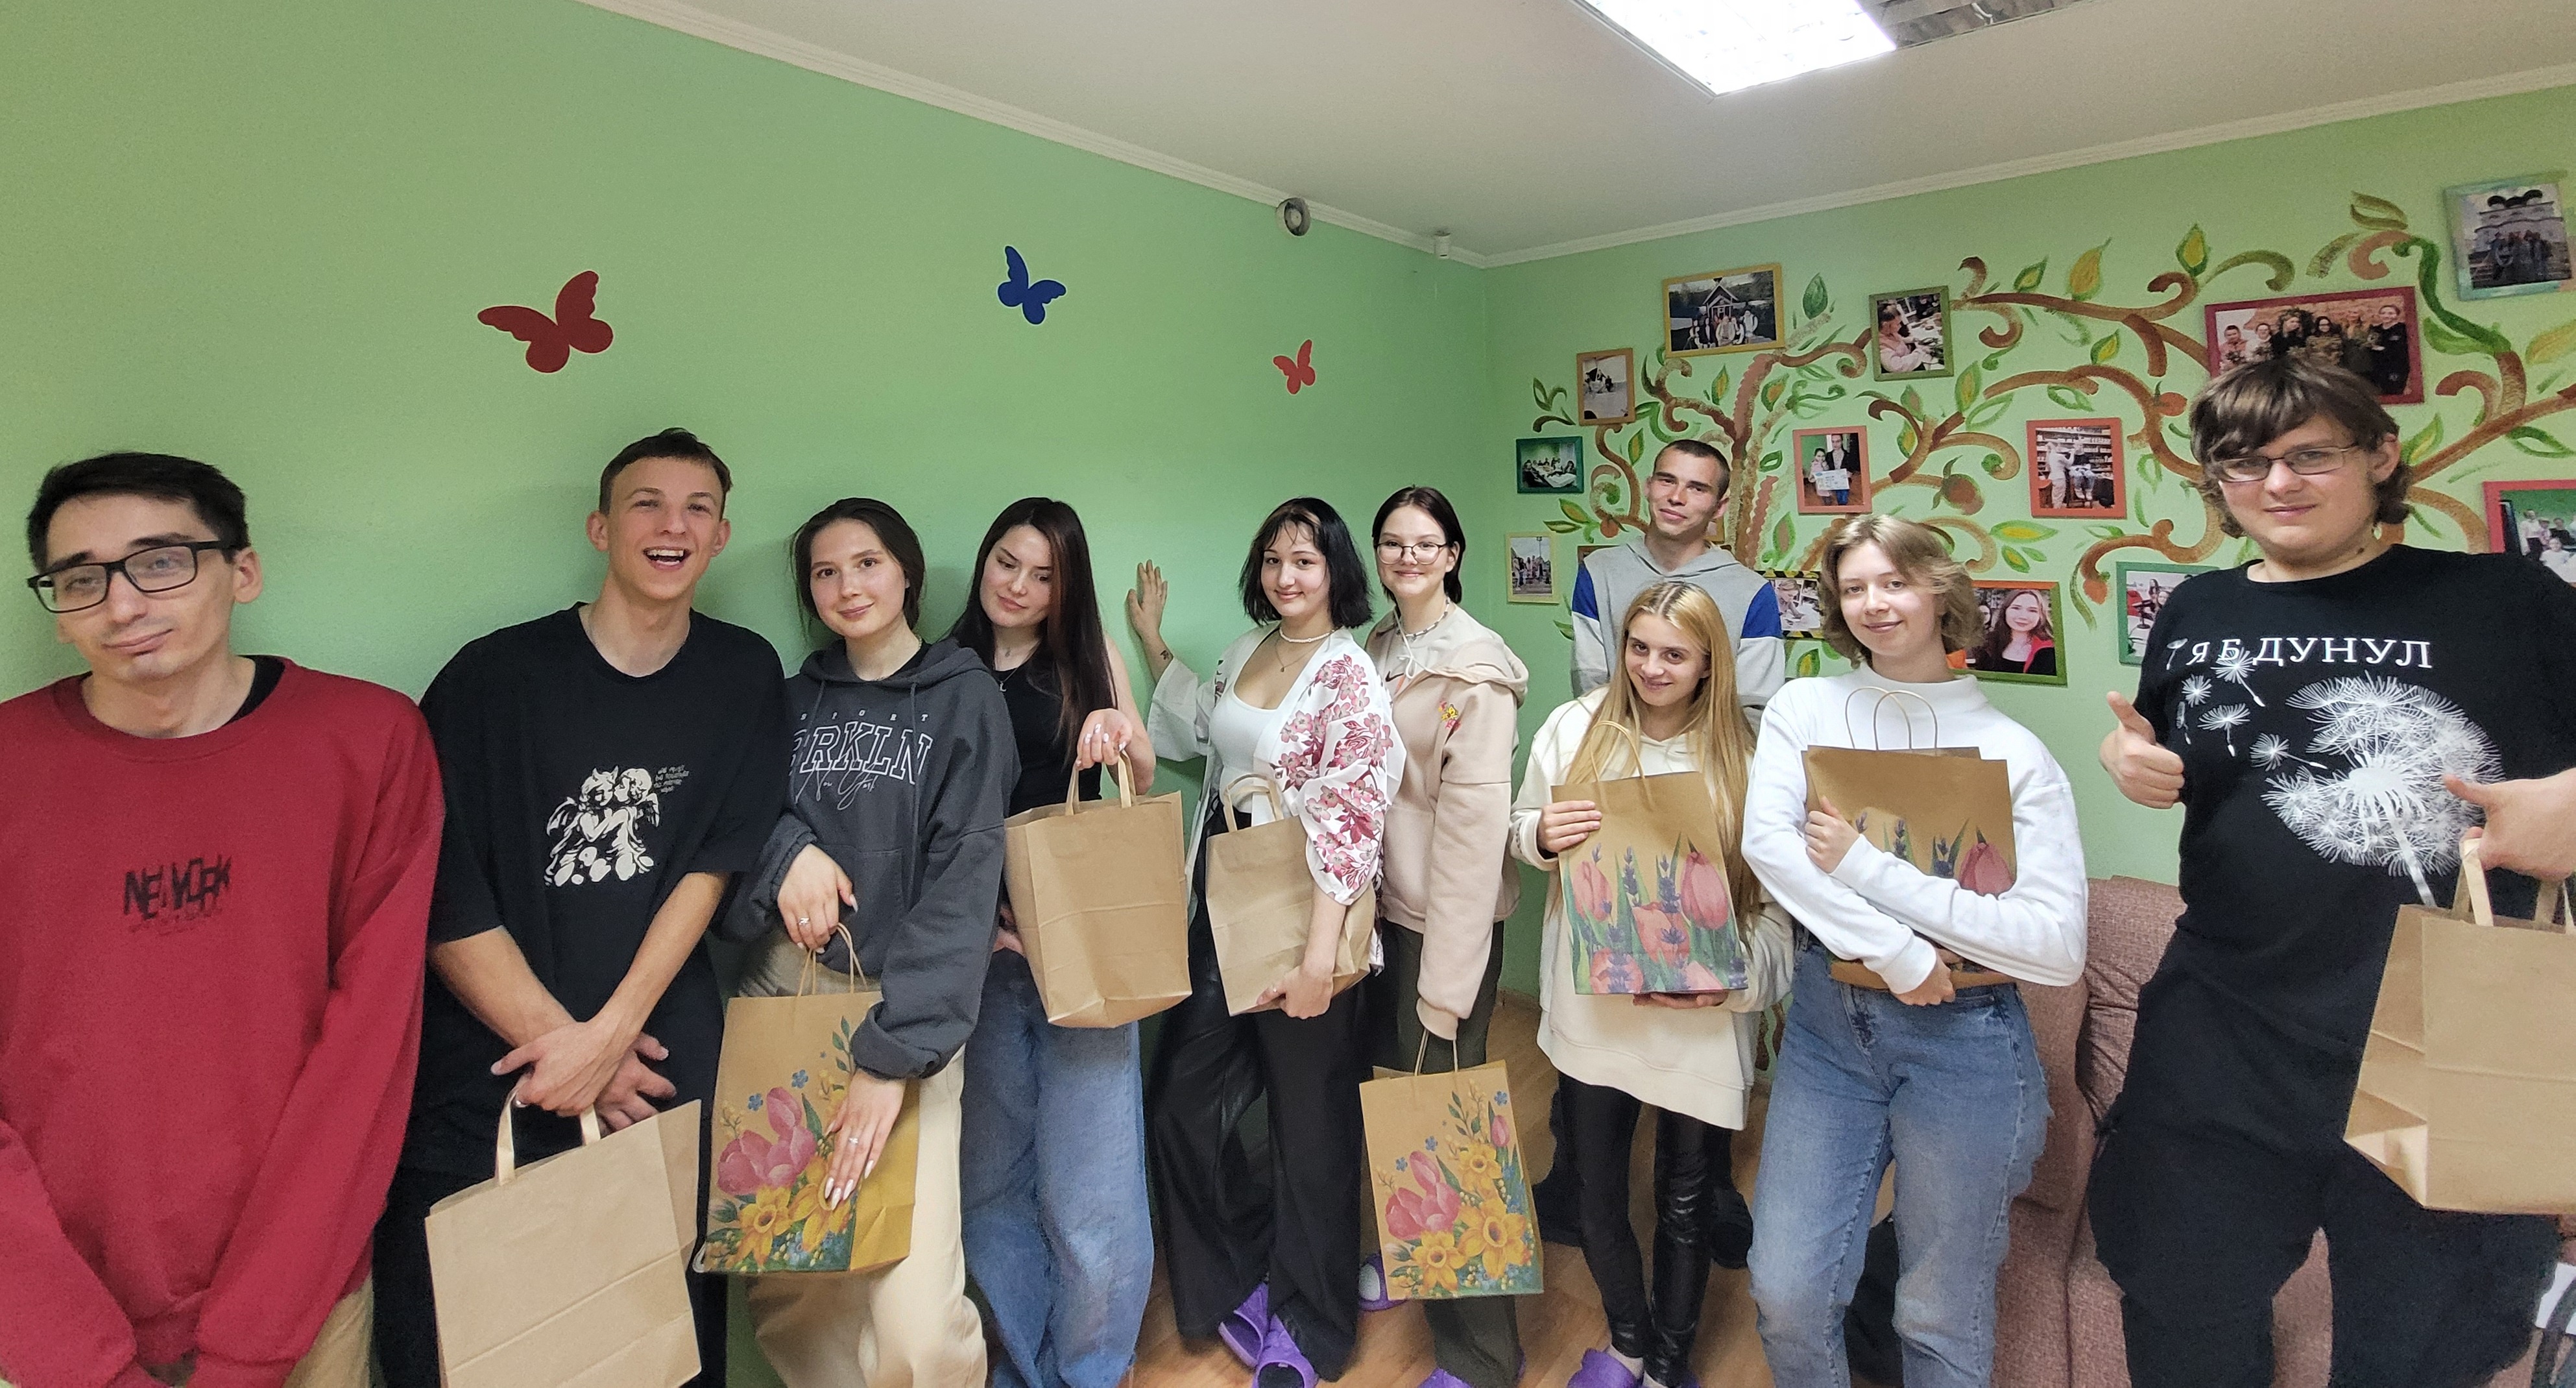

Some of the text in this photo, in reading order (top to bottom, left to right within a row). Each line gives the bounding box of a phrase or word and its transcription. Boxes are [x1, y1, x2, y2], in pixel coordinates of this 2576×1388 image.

[2185, 637, 2433, 669] Я Б ДУНУЛ
[800, 709, 929, 722] SPORT
